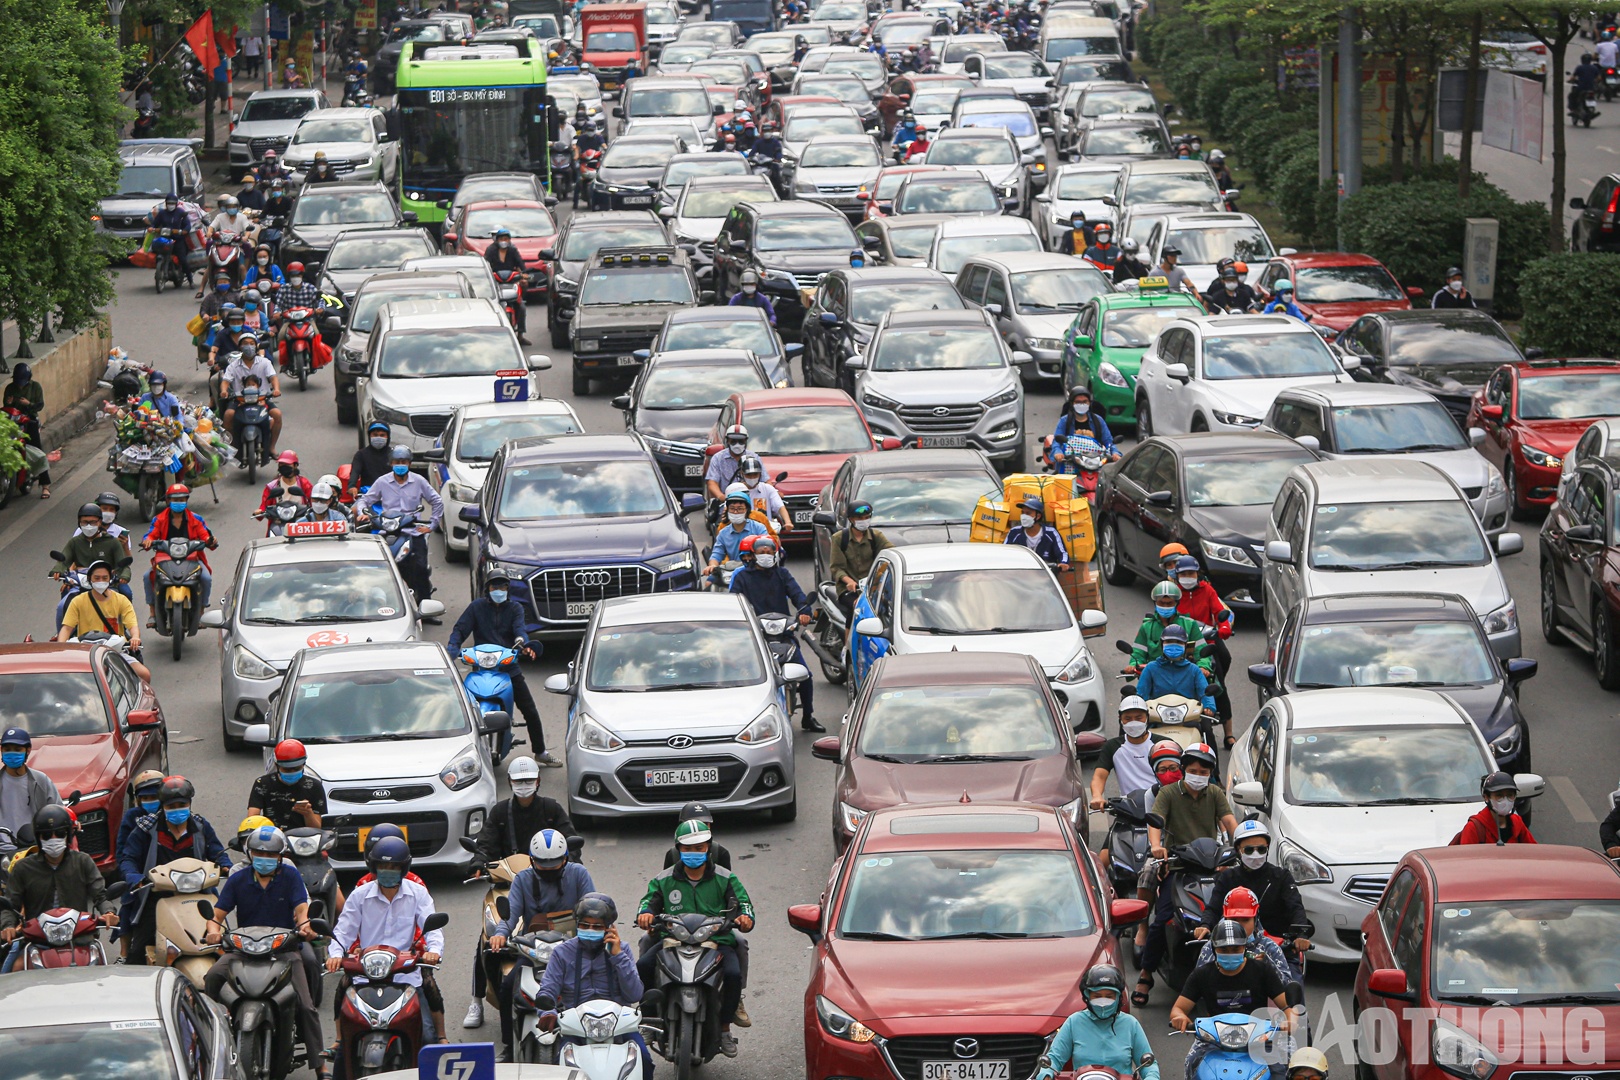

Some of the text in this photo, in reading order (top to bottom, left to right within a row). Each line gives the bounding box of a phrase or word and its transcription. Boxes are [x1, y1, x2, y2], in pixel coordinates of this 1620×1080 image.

[430, 90, 445, 103] E01
[502, 381, 521, 400] G7
[289, 520, 345, 534] Taxi 123
[654, 769, 717, 785] 30E-415.98
[670, 904, 683, 912] Grab
[437, 1051, 476, 1080] G7
